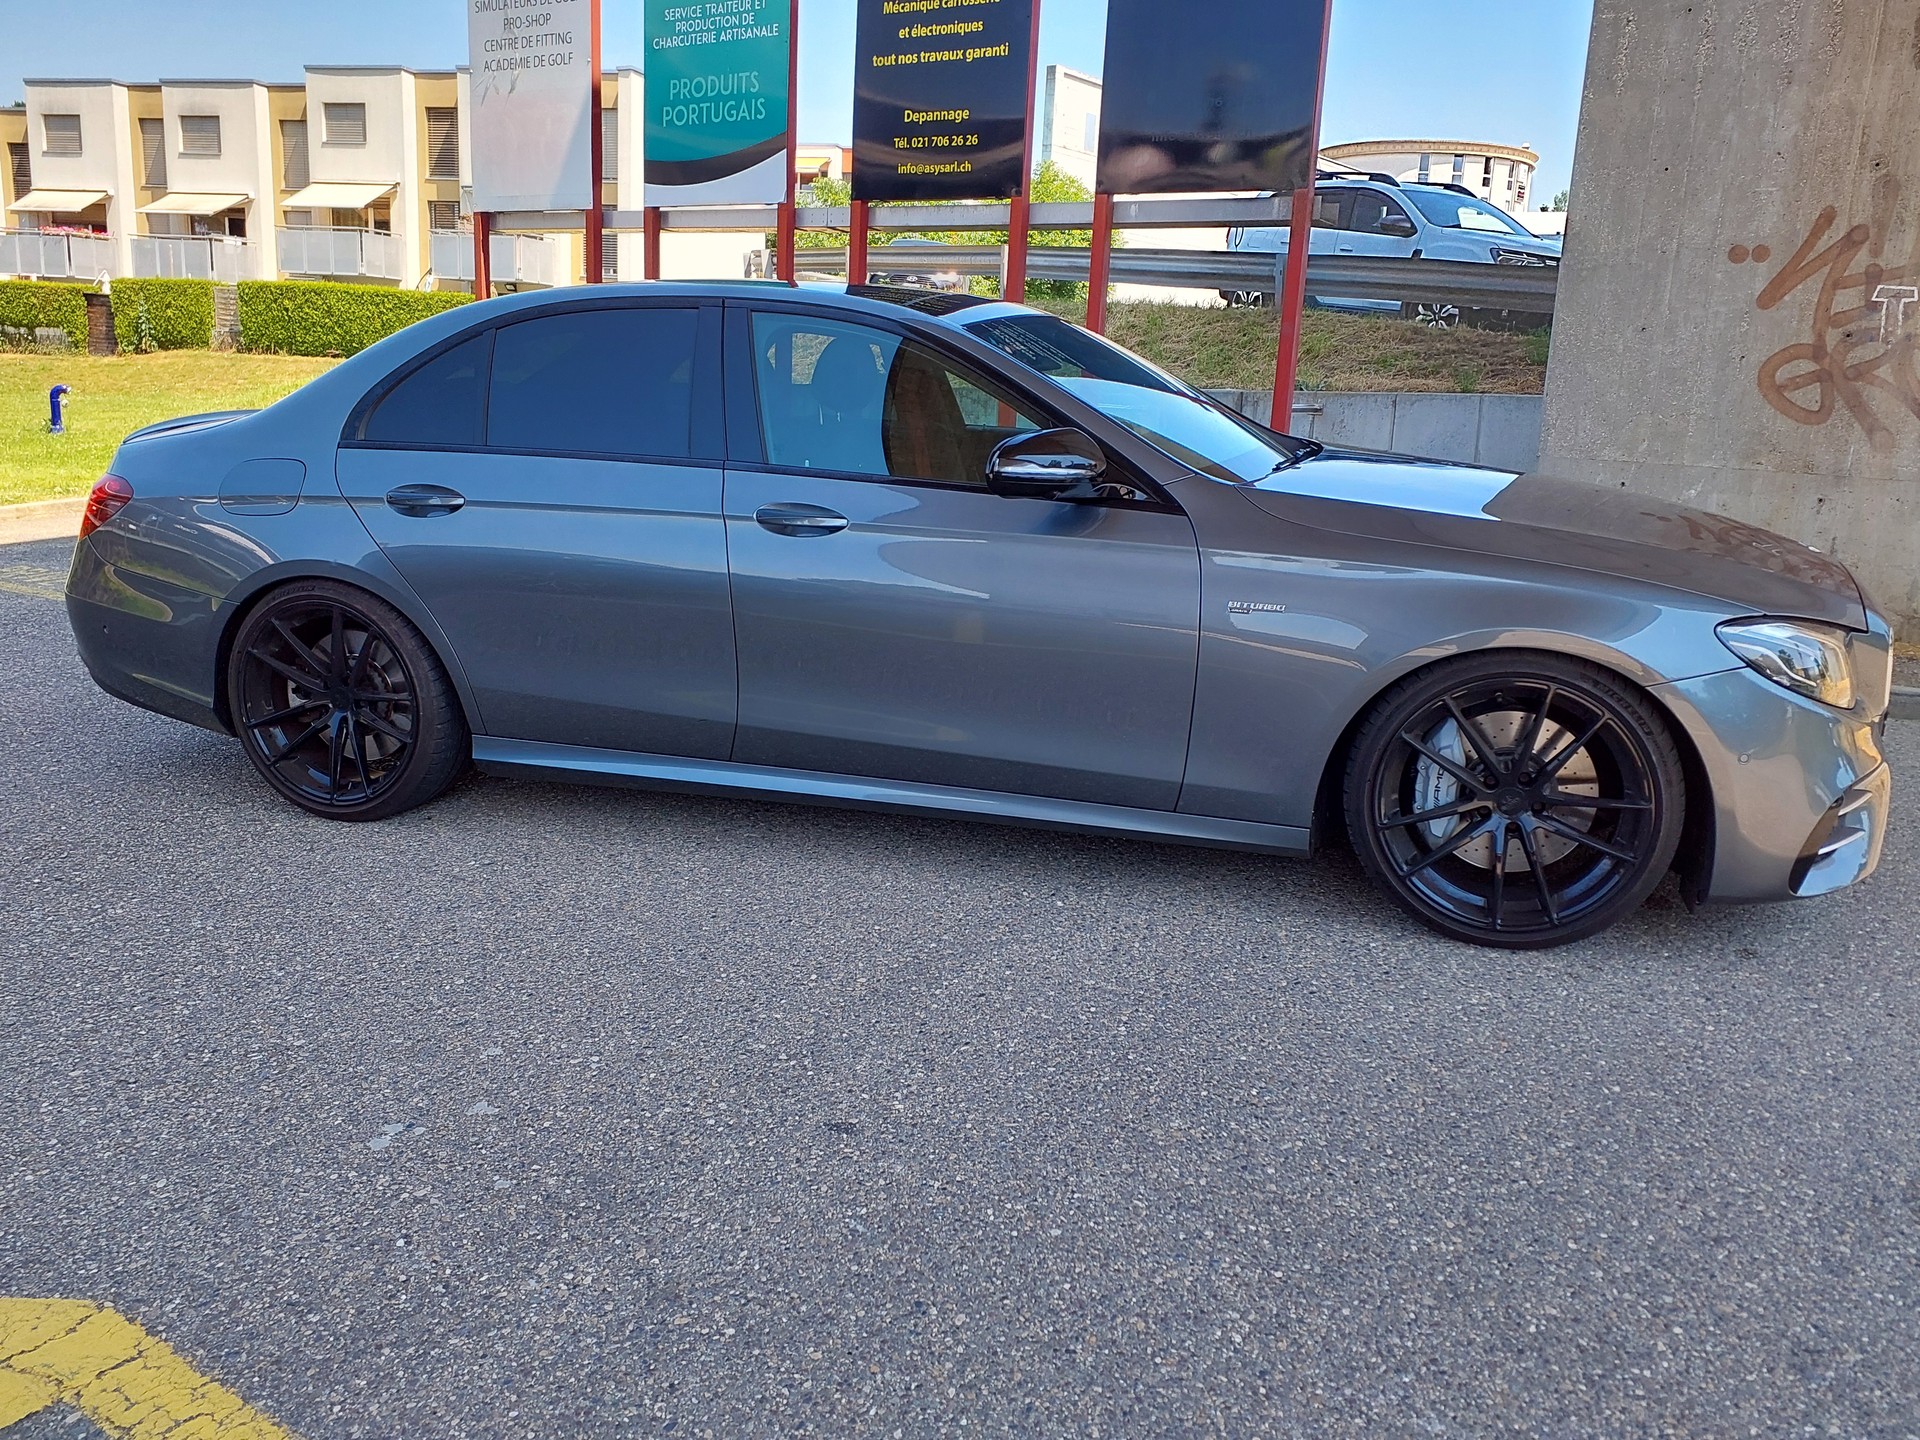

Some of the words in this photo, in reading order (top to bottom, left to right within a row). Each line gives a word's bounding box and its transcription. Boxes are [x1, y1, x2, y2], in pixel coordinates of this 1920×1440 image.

[664, 5, 703, 21] SERVICE
[705, 0, 752, 16] TRAITEUR
[883, 0, 939, 14] Mécanique
[941, 0, 1000, 8] carros
[503, 12, 552, 30] PRO-SHOP
[675, 14, 739, 33] PRODUCTION
[742, 12, 755, 25] DE
[898, 26, 910, 38] et
[911, 20, 984, 37] électroniques
[484, 37, 519, 52] CENTRE
[521, 35, 534, 49] DE
[535, 31, 573, 47] FITTING
[653, 31, 717, 49] CHARCUTERIE
[719, 23, 779, 42] ARTISANALE
[483, 56, 531, 72] ACADEMIE
[533, 54, 546, 68] DE
[548, 52, 574, 67] GOLF
[872, 54, 896, 67] tout
[898, 53, 918, 64] nos
[920, 48, 964, 63] travaux
[965, 42, 1009, 62] garanti
[669, 71, 760, 100] PRODUITS
[663, 97, 766, 128] PORTUGAIS
[904, 109, 970, 125] Depannage
[893, 137, 910, 148] Tél.
[911, 137, 929, 148] 021
[931, 136, 950, 147] 706
[951, 135, 964, 146] 26
[965, 134, 979, 146] 26
[897, 160, 972, 175] info@asysarl.ch
